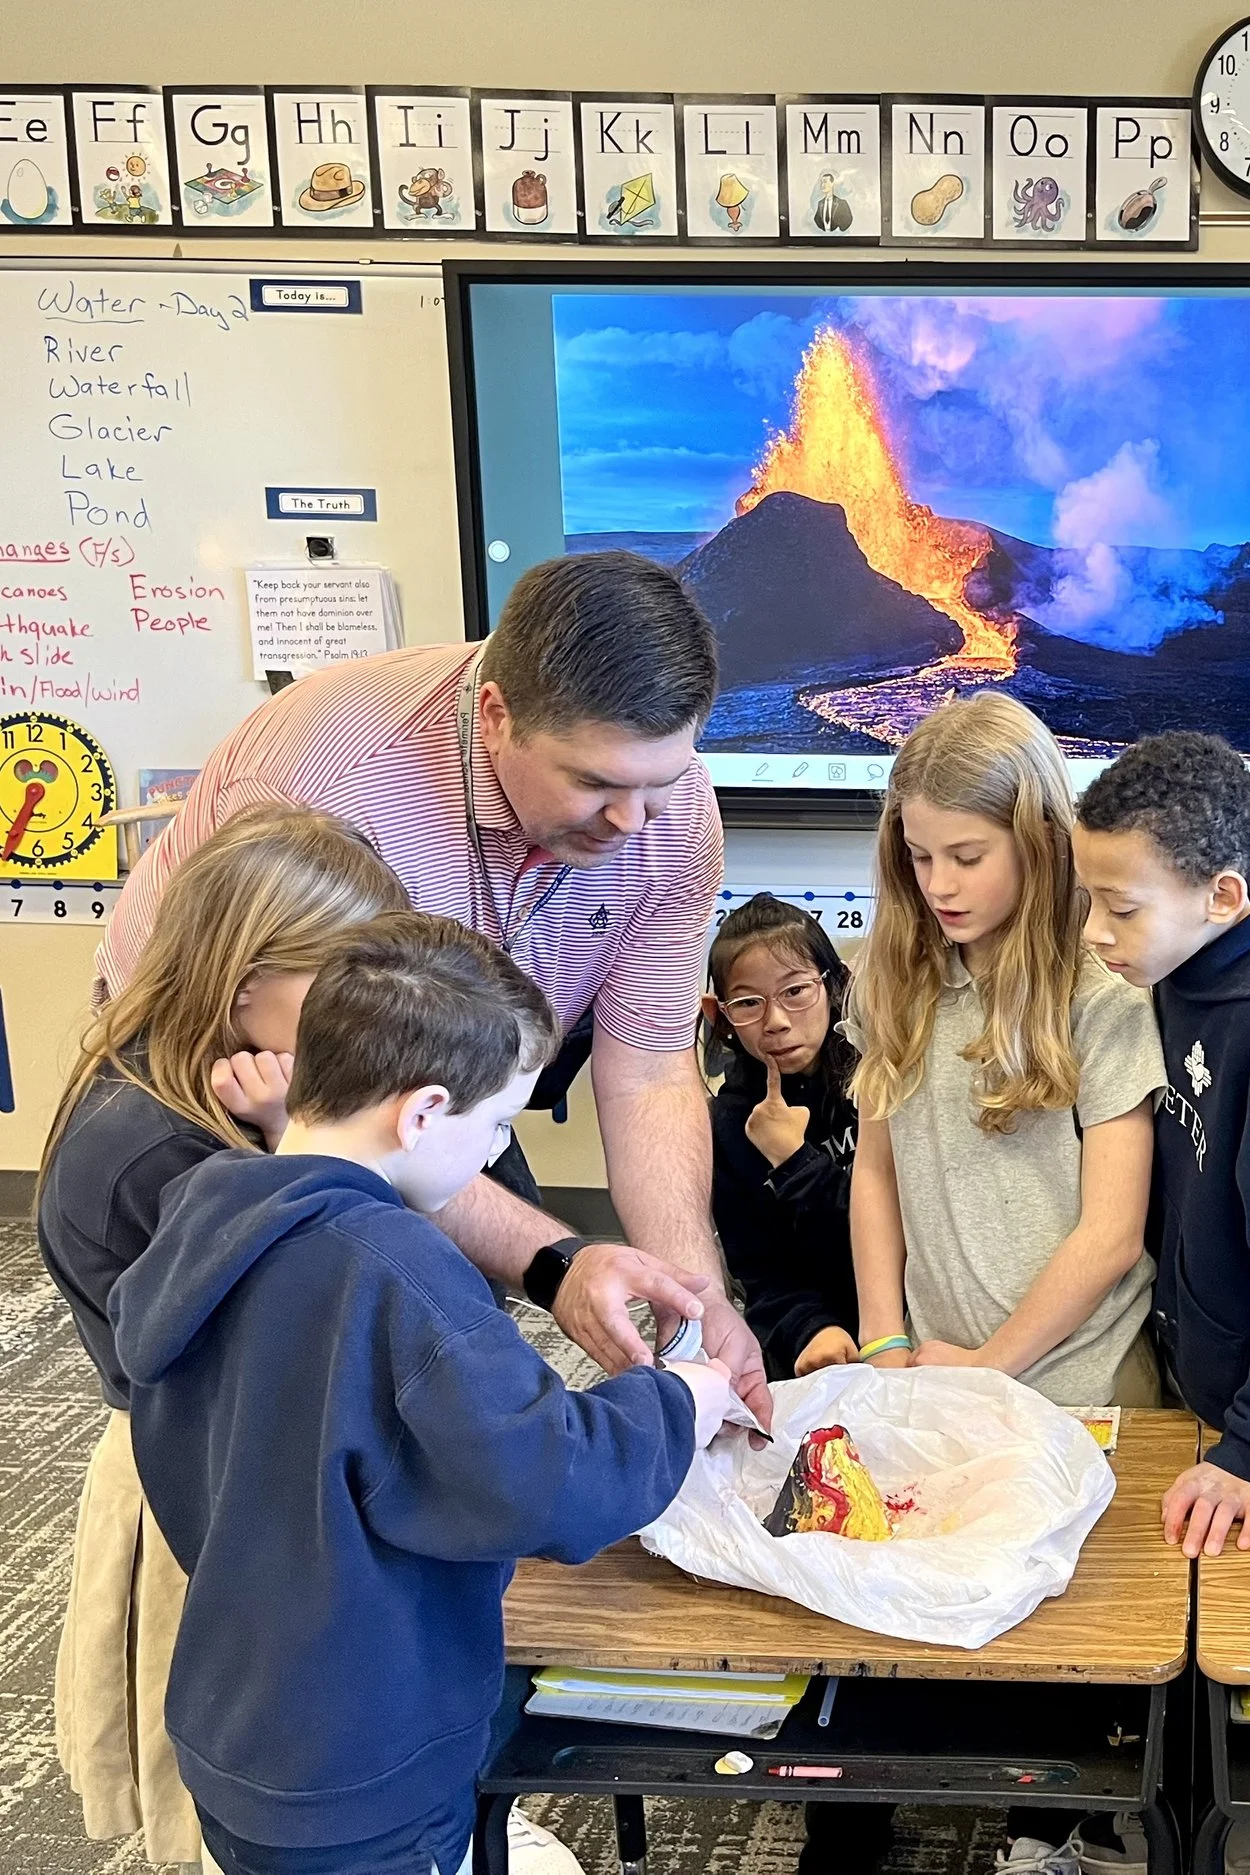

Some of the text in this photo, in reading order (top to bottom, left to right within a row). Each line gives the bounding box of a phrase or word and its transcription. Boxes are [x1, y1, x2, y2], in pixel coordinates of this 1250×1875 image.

[1218, 55, 1236, 75] 10
[1210, 96, 1220, 114] 9
[92, 101, 146, 142] Ff
[296, 102, 352, 145] Hh
[397, 105, 444, 148] Ii
[191, 104, 250, 166] Gg
[500, 109, 550, 161] Jj
[599, 112, 654, 155] Kk
[703, 113, 750, 156] Ll
[803, 113, 861, 155] Mm
[909, 113, 964, 156] Nn
[1010, 115, 1069, 158] Oo
[1115, 117, 1173, 168] Pp
[1219, 132, 1229, 152] 8
[37, 280, 146, 319] Water
[228, 295, 249, 322] 2
[276, 289, 311, 304] Today
[420, 295, 446, 309] 1:0
[43, 335, 123, 364] River
[48, 372, 191, 407] Waterfall
[48, 413, 173, 442] Glacier
[62, 454, 144, 481] Lake
[64, 490, 153, 533] Pond
[291, 498, 350, 510] The Truth
[129, 573, 225, 601] Erosion
[281, 580, 300, 589] back
[303, 582, 321, 591] your
[324, 581, 352, 589] servant
[355, 580, 370, 588] also
[255, 594, 277, 603] from
[280, 595, 336, 606] presumptuous
[358, 593, 368, 602] let
[130, 608, 212, 635] People
[256, 608, 278, 617] them
[281, 609, 294, 617] not
[296, 608, 316, 617] have
[318, 608, 354, 617] dominion
[275, 622, 297, 631] Then
[305, 622, 324, 631] shall
[326, 622, 335, 631] be
[258, 636, 347, 648] and innocent of great
[21, 642, 74, 666] slide
[324, 650, 349, 659] Psalm
[2, 731, 14, 749] 11
[26, 724, 44, 743] 12
[60, 732, 66, 750] 1
[81, 755, 93, 773] 2
[91, 783, 102, 801] 3
[81, 812, 93, 830] 4
[32, 840, 44, 857] 6
[62, 832, 74, 850] 5
[11, 899, 104, 919] 7 8 9
[837, 910, 863, 928] 28
[1162, 1085, 1207, 1172] ETER
